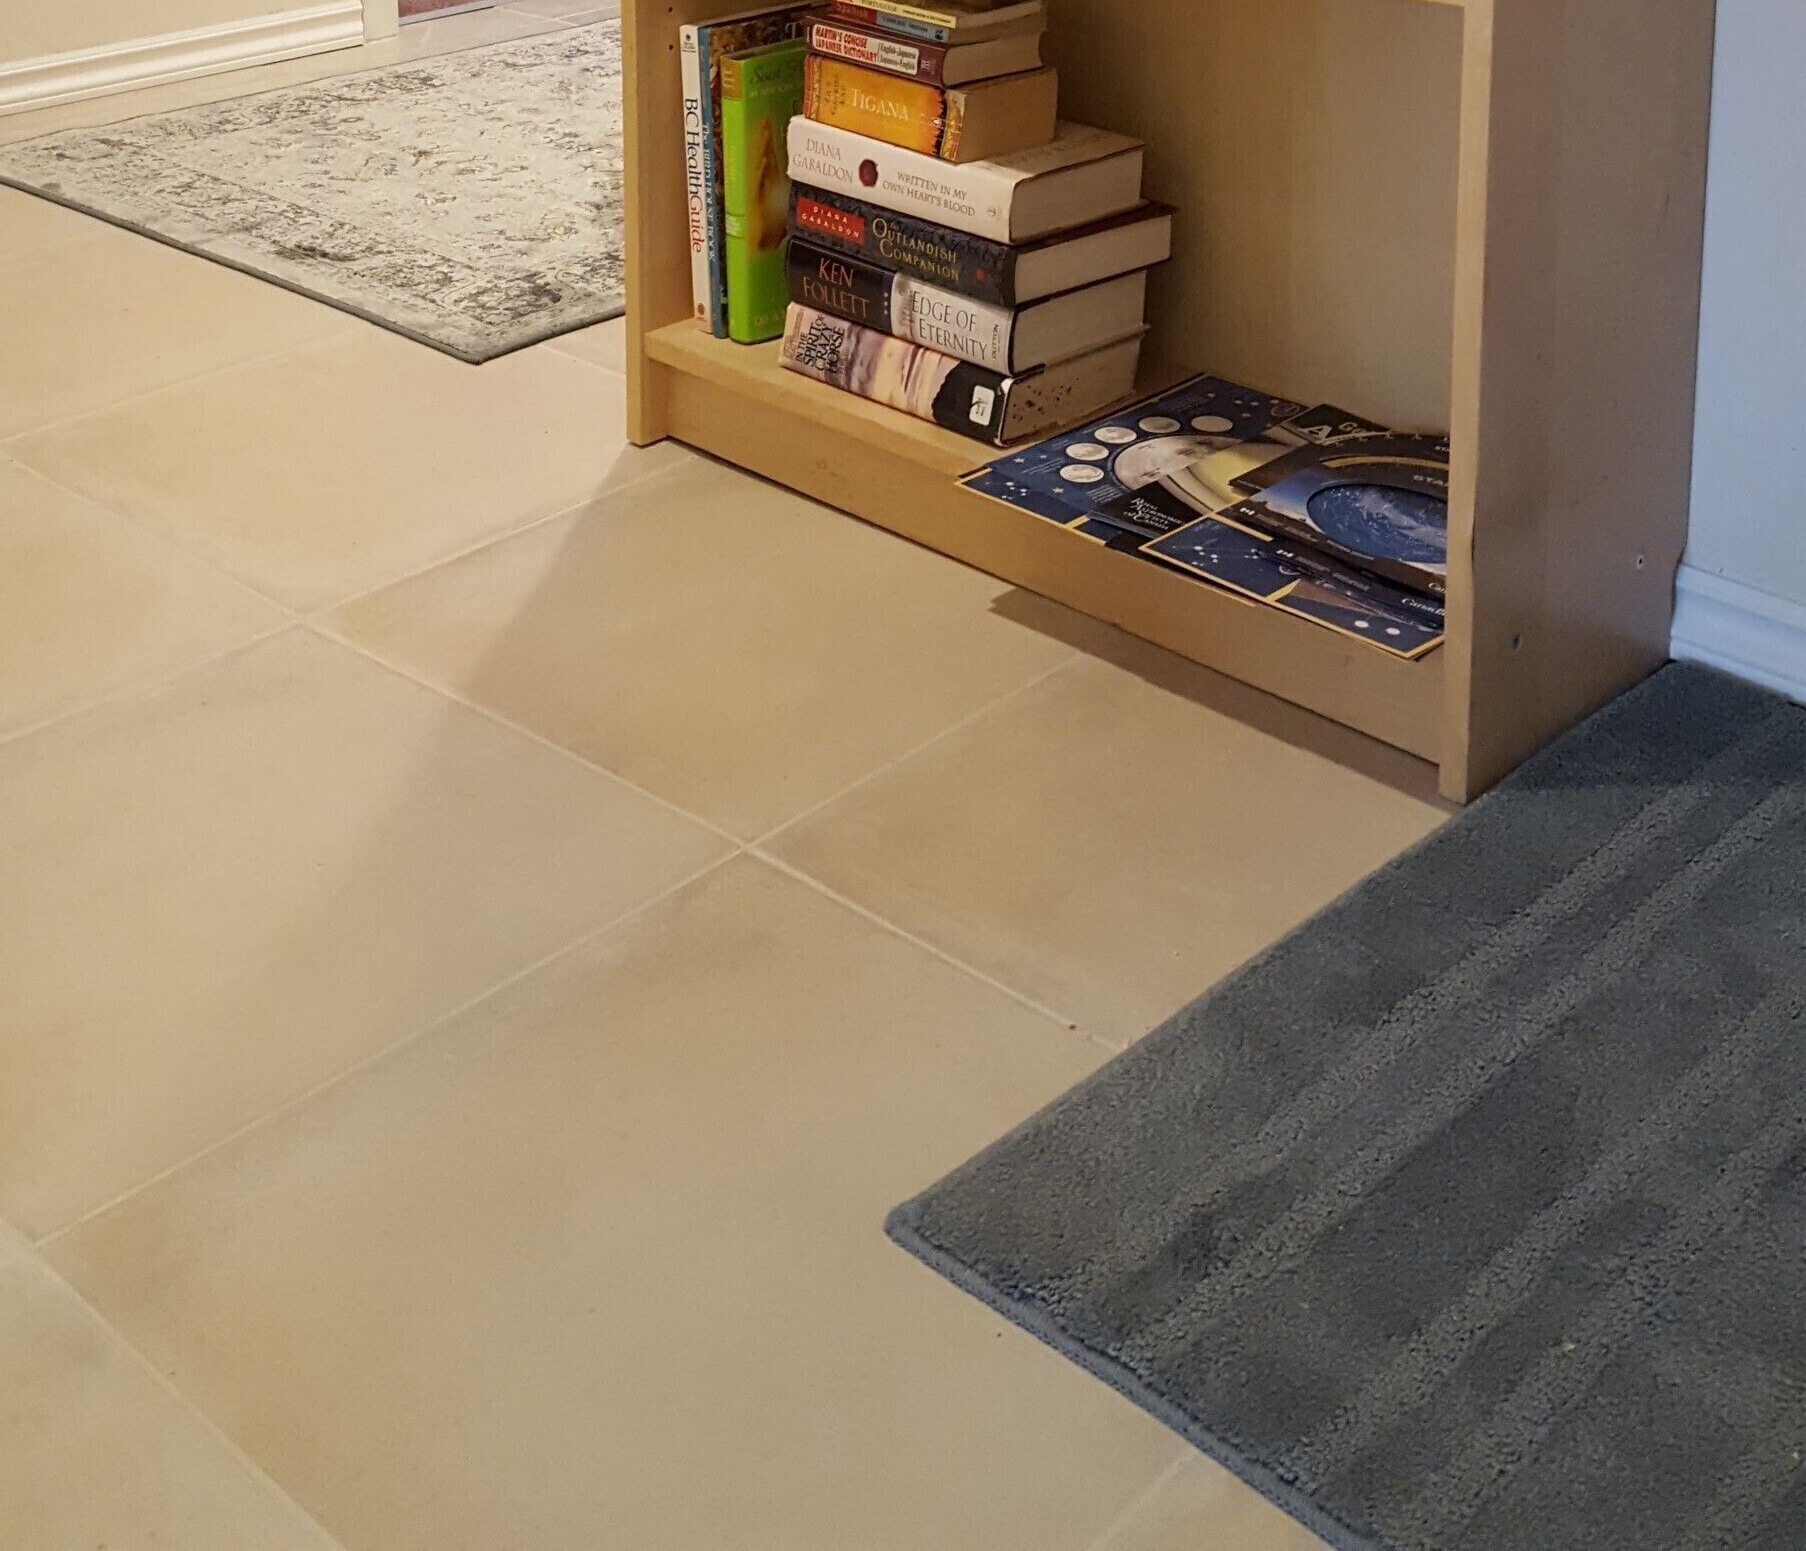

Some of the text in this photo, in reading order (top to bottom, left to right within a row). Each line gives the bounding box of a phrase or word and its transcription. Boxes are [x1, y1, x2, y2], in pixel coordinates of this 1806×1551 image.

[815, 26, 868, 49] MARTIN'S CONCISE
[815, 38, 877, 62] JAPANESE DICTIONARY
[684, 98, 699, 130] BC
[851, 88, 909, 122] TIGANA
[806, 137, 841, 161] DIANA
[792, 154, 853, 183] GABALDON
[883, 181, 975, 216] OWN HEART'S BLOOD
[897, 171, 968, 201] WRITTEN IN MY
[801, 213, 860, 238] GABALDON
[813, 206, 848, 224] DIANA
[872, 218, 957, 264] OUTLANDISH
[818, 257, 854, 289] KEN
[879, 240, 959, 282] COMPANION
[803, 276, 870, 319] FOLLETT
[911, 290, 977, 332] EDGE OF
[795, 332, 808, 363] IN THE
[803, 313, 824, 367] SPIRIT OF
[815, 323, 833, 371] CRAZY
[825, 326, 845, 374] HORSE
[919, 318, 988, 361] ETERNITY
[991, 324, 999, 360] DUTTON
